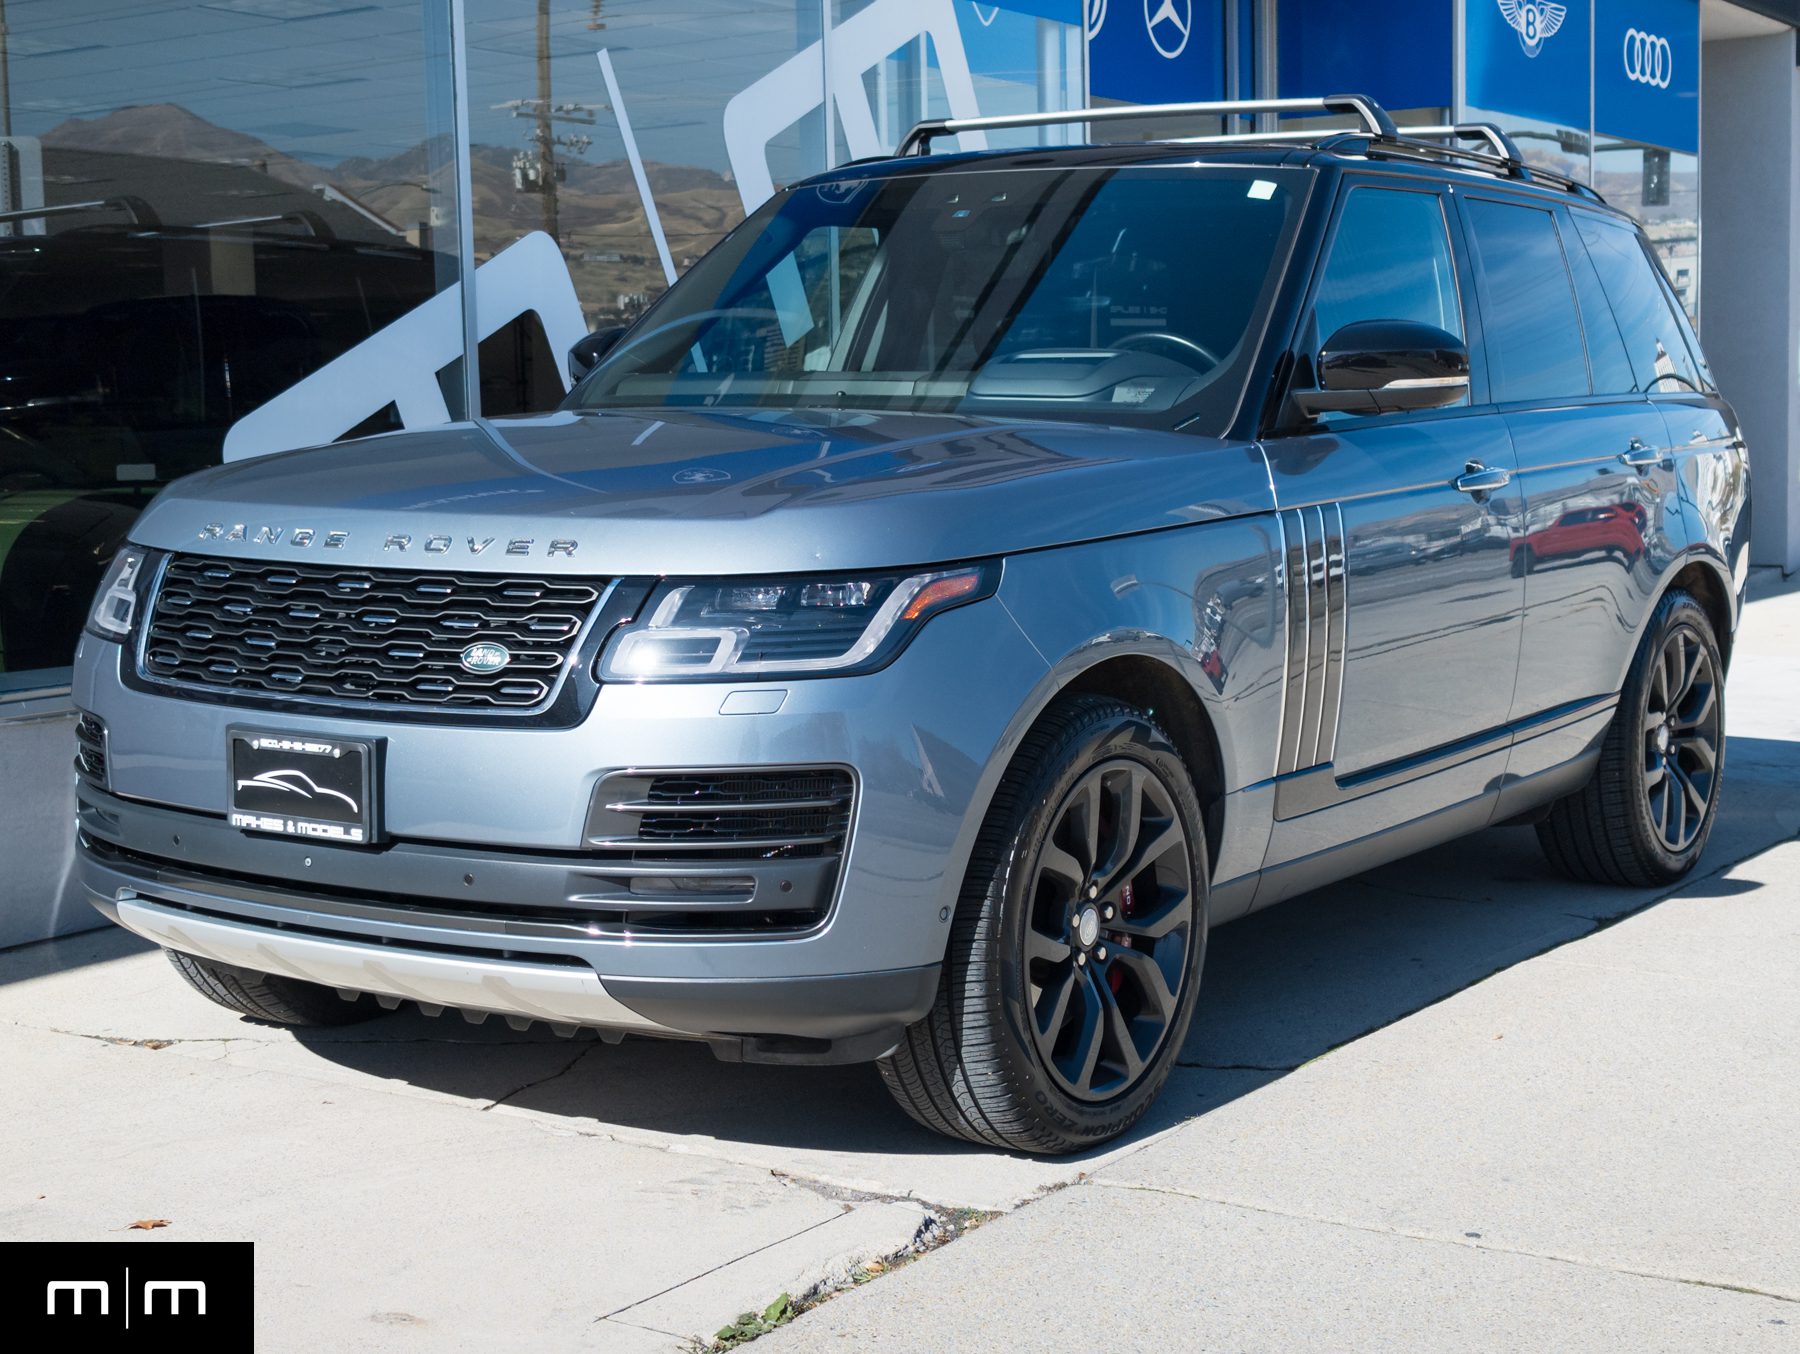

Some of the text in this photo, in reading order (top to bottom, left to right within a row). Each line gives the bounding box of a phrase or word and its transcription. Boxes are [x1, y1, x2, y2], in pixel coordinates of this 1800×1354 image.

[1526, 8, 1537, 40] B
[198, 522, 579, 558] RANGE ROVER
[470, 647, 496, 657] LAND
[470, 656, 501, 666] ROVER
[297, 821, 363, 841] MODELS
